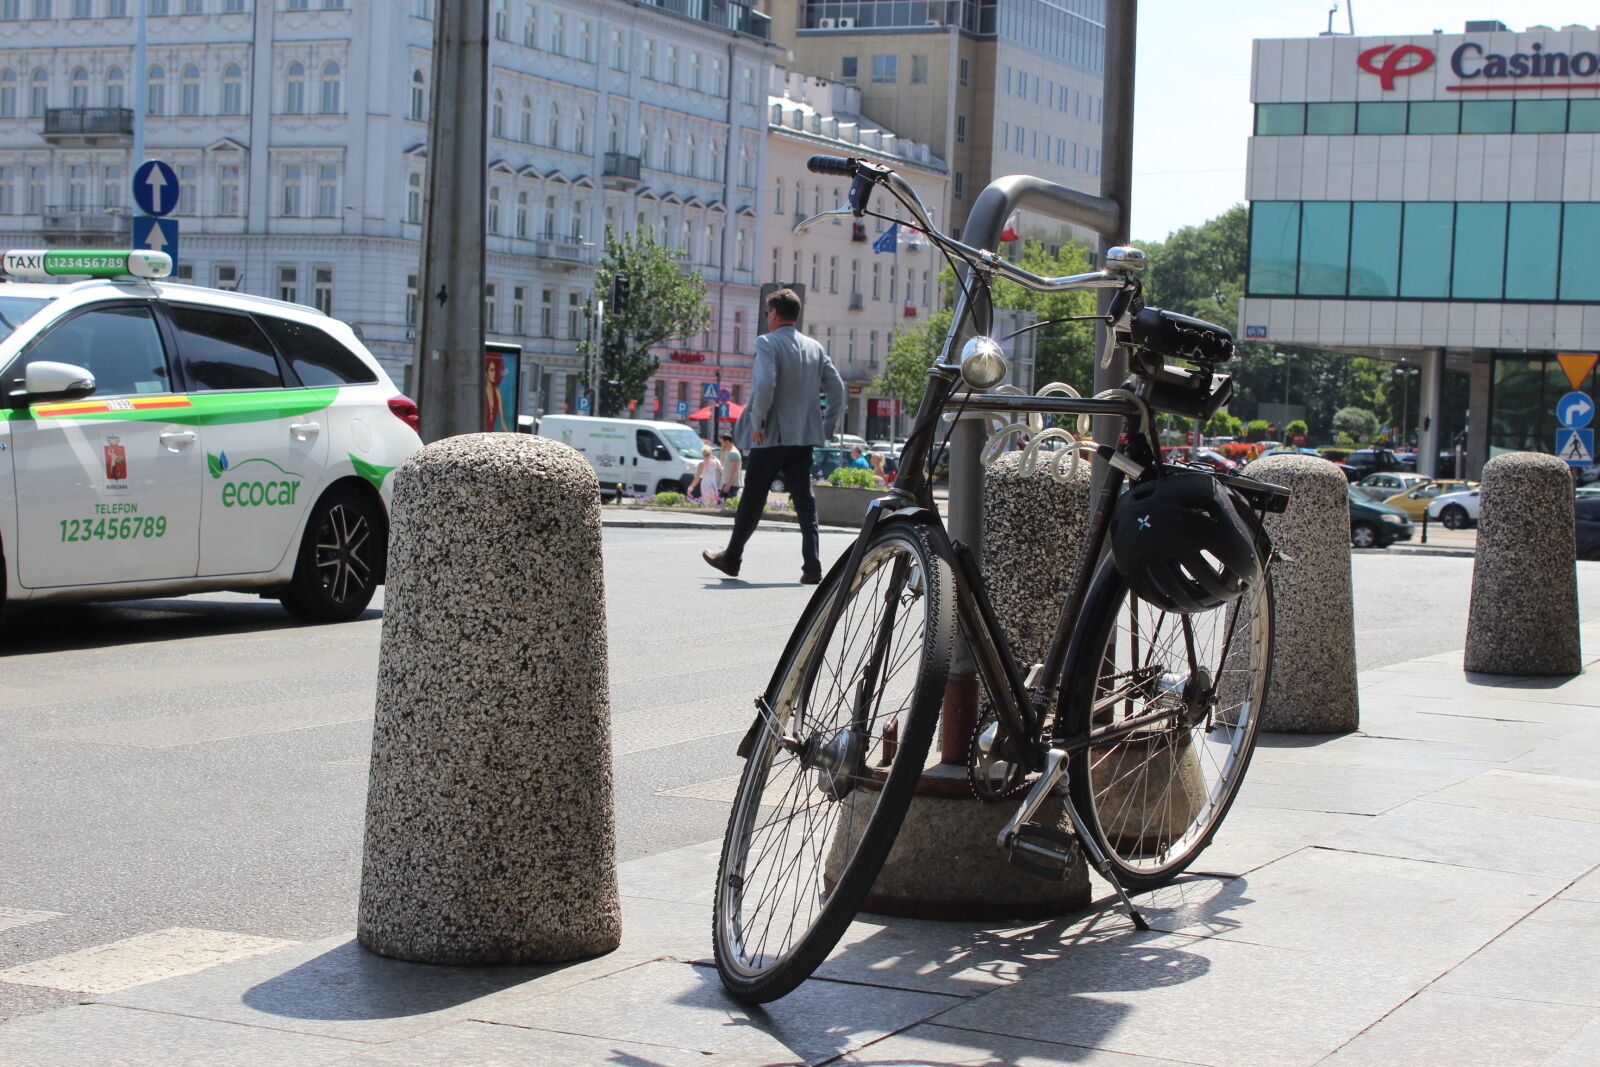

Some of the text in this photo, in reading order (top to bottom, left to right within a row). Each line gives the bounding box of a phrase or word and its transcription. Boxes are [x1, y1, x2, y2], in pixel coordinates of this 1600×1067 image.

[1451, 42, 1600, 79] Casino
[7, 255, 41, 269] TAXI
[53, 257, 124, 269] 123456789
[222, 480, 301, 508] ecocar
[95, 503, 138, 514] TELEFON
[60, 515, 167, 542] 123456789
